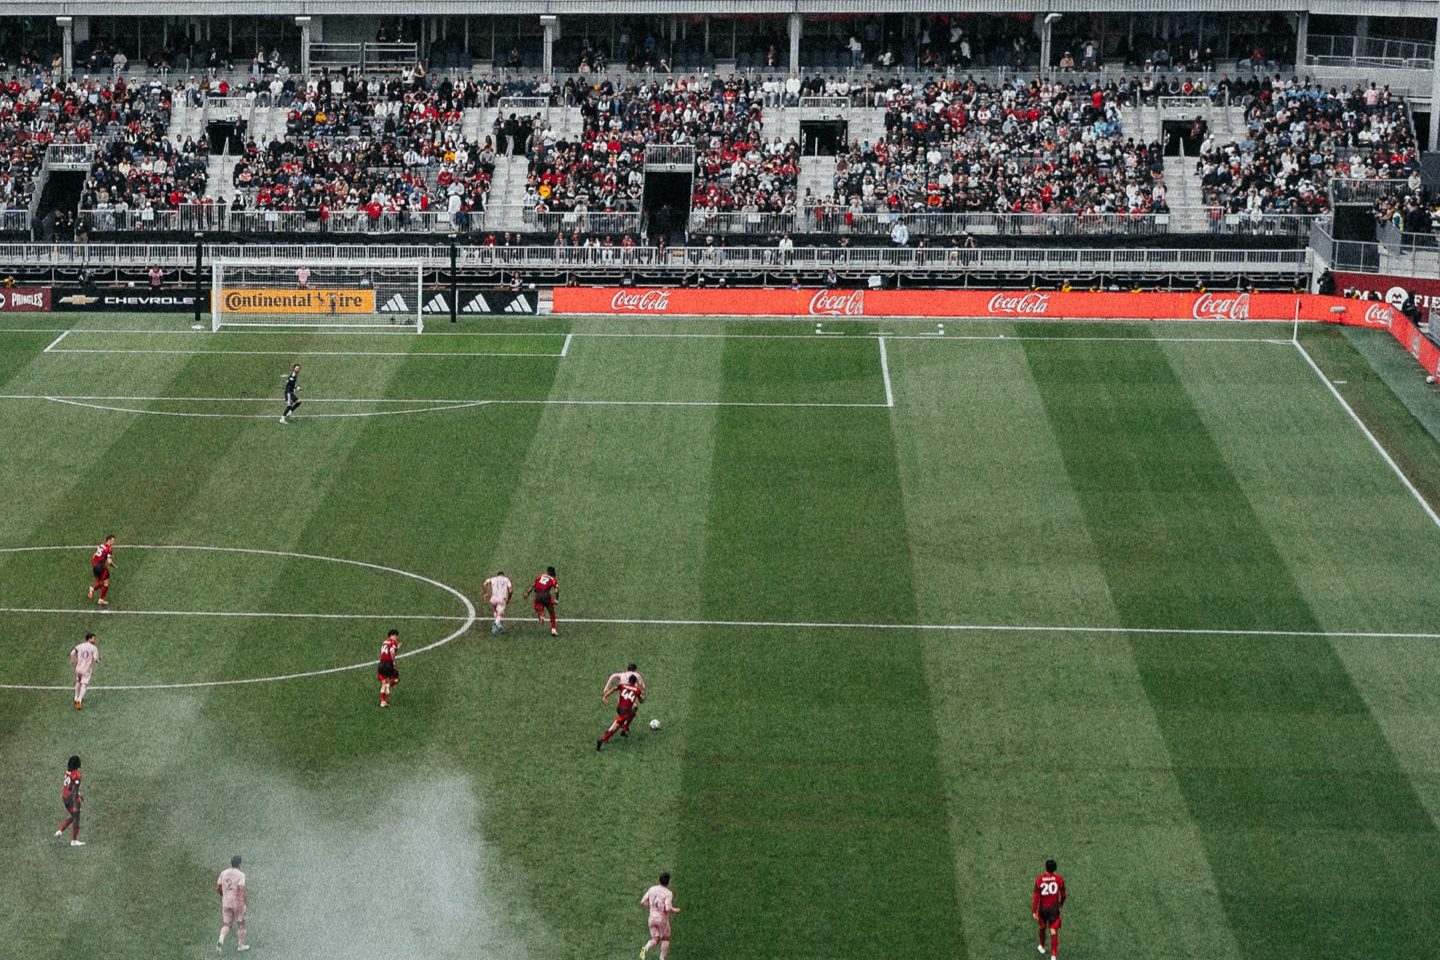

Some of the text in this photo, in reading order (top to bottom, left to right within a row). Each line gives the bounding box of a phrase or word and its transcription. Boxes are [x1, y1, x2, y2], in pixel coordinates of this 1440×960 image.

[11, 292, 43, 307] PRINGLES
[225, 292, 312, 310] Continental
[621, 688, 638, 702] 44
[1040, 882, 1059, 896] 20
